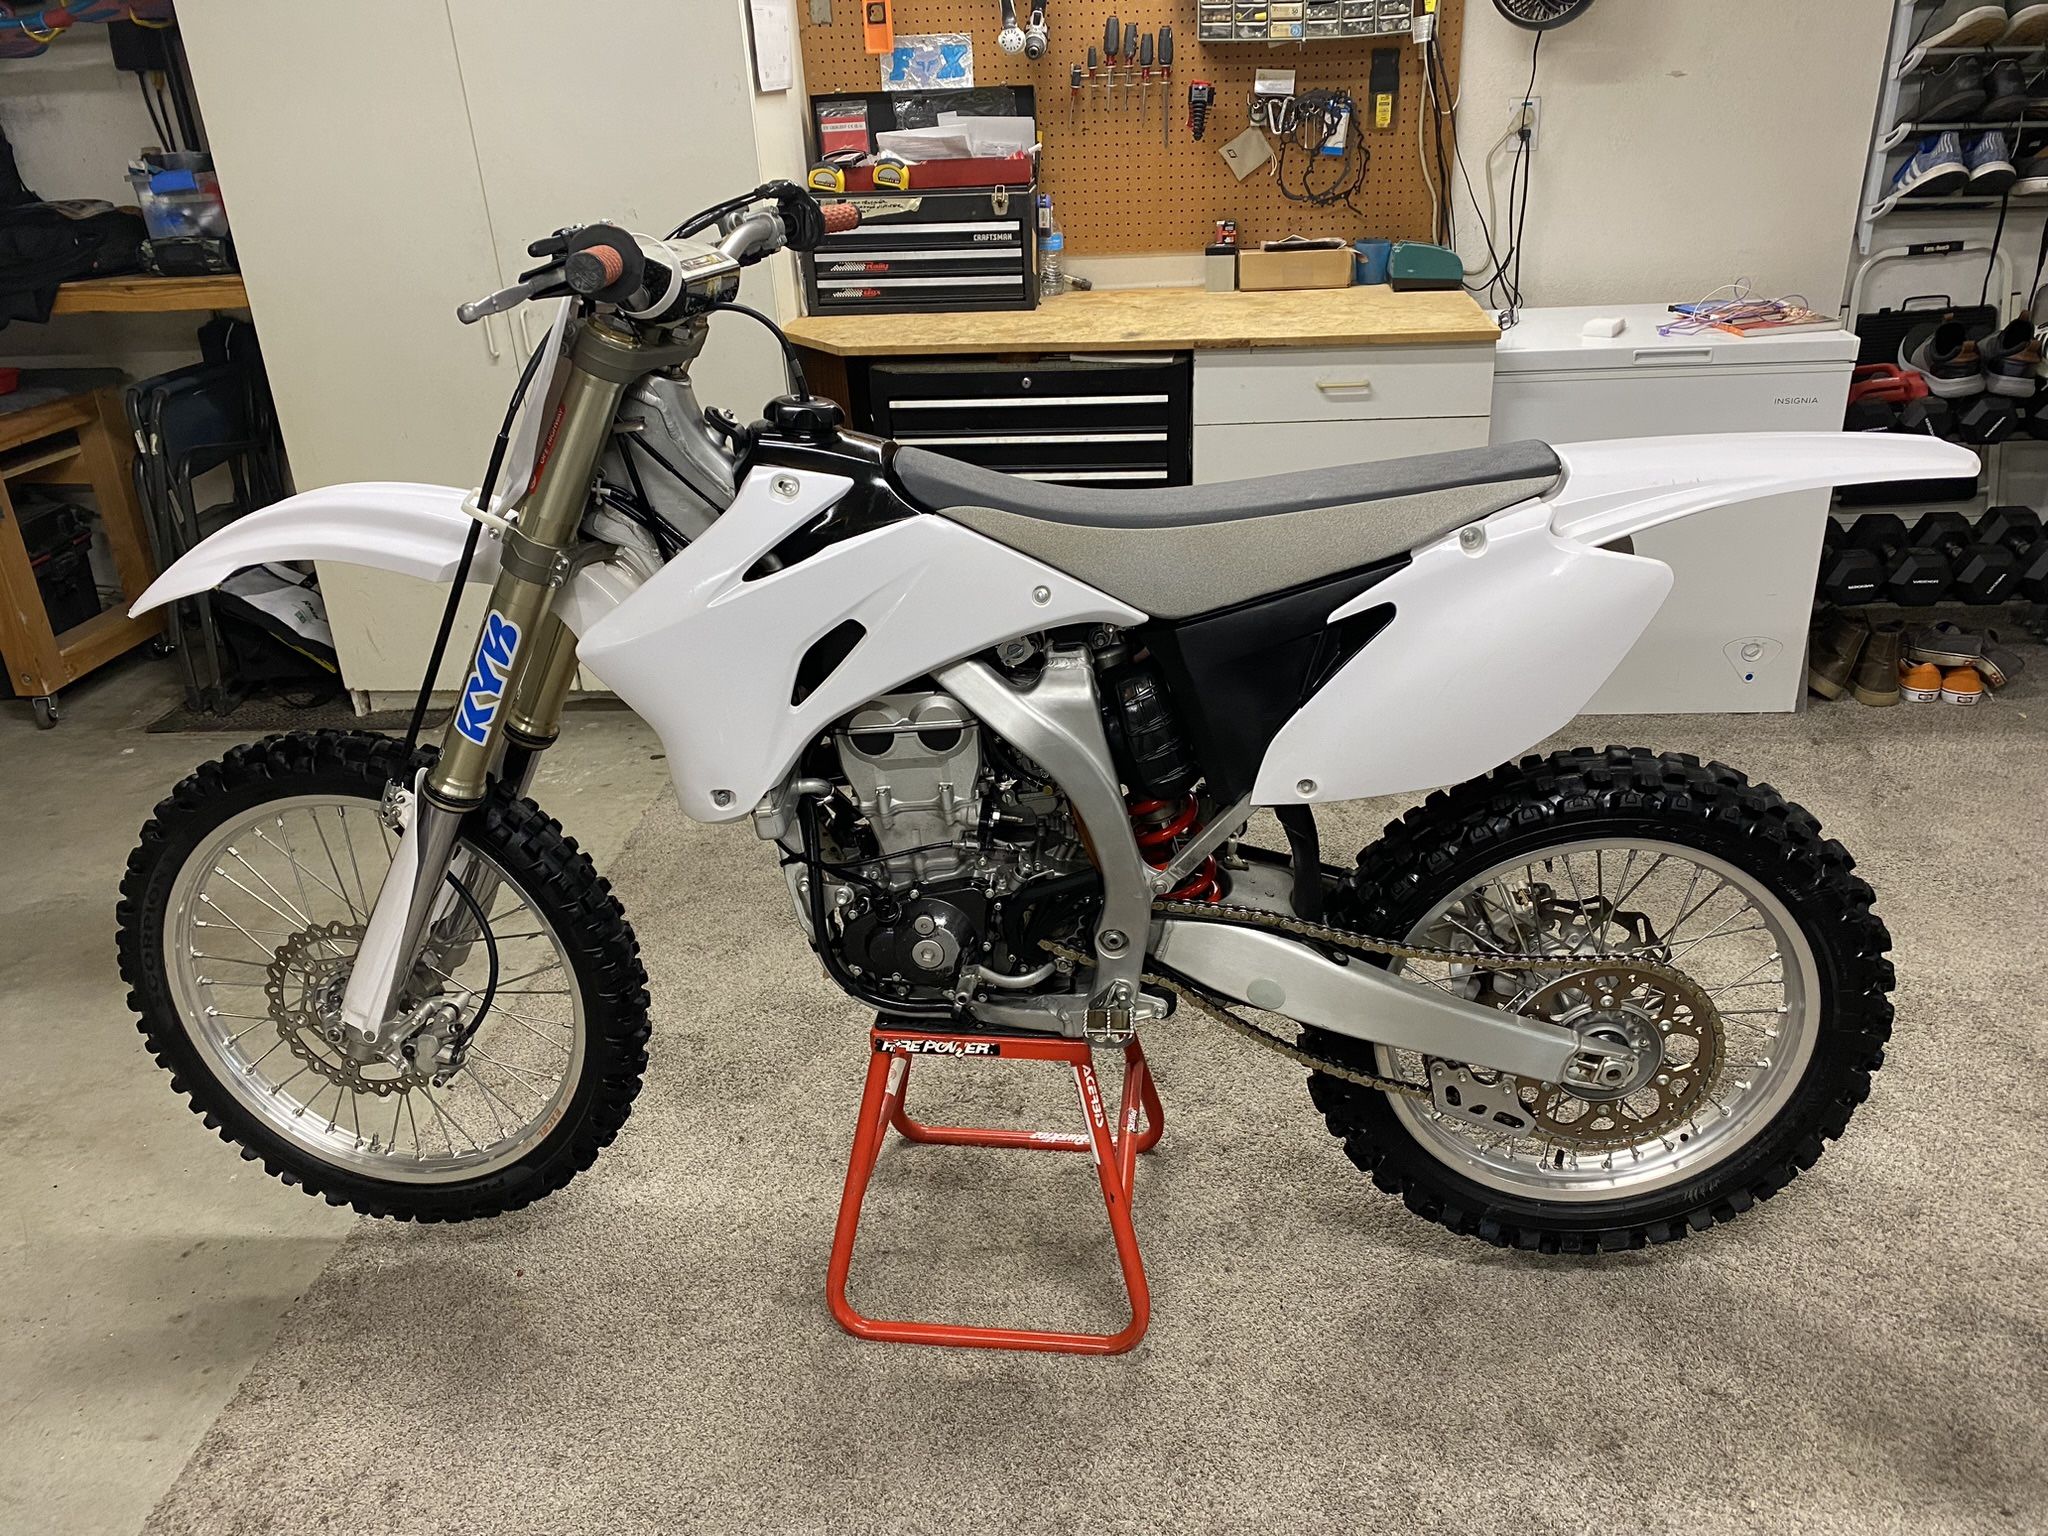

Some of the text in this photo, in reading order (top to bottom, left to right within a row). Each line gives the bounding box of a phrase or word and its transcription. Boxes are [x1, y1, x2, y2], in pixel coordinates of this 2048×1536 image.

[973, 233, 1013, 241] CRAFTSMAN
[1774, 397, 1818, 405] INSIGNIA
[454, 608, 523, 748] KYB
[881, 1039, 990, 1058] FIRE POWER
